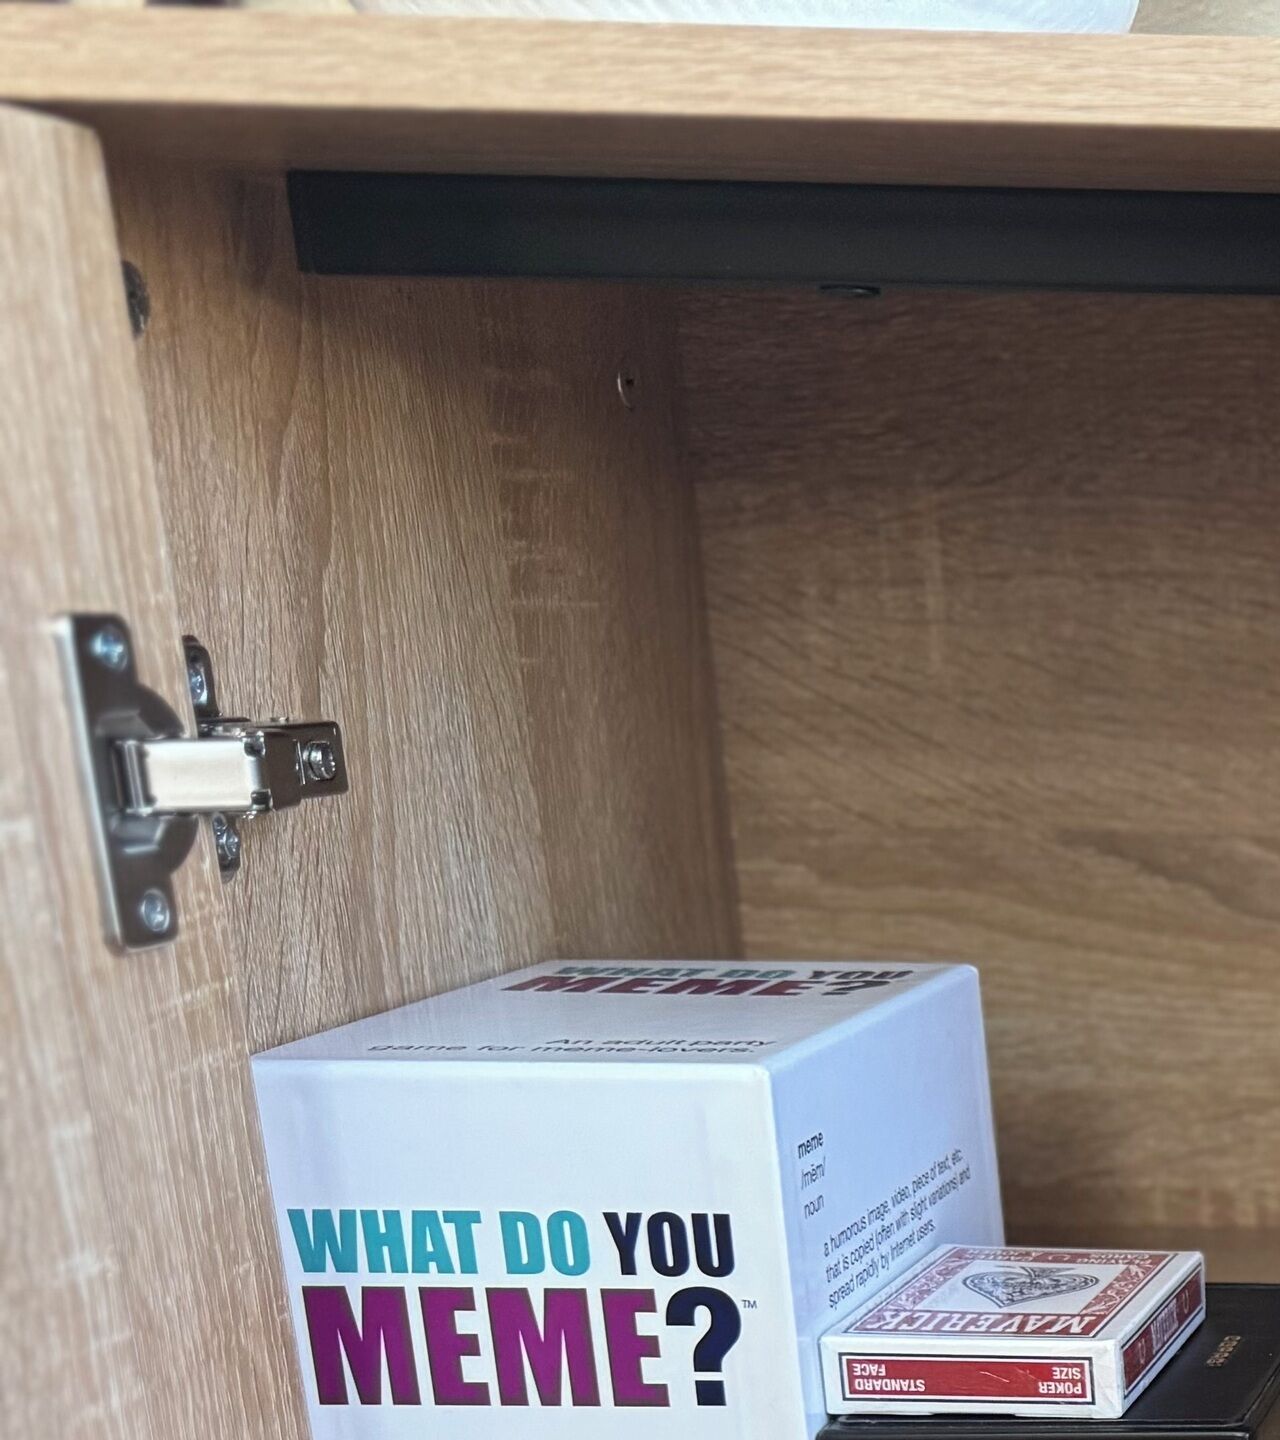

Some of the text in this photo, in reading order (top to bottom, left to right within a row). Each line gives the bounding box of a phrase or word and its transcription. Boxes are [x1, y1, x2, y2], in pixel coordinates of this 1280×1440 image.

[556, 967, 914, 980] WHAT DO YOU
[501, 976, 889, 997] MEME?
[602, 1038, 687, 1046] adult
[688, 1039, 778, 1047] party
[797, 1132, 824, 1159] meme
[804, 1194, 824, 1219] noun
[287, 1208, 736, 1278] WHAT DO YOU
[865, 1311, 1096, 1333] MAVERICK
[301, 1285, 742, 1407] MEME?
[853, 1363, 886, 1377] FACE
[1052, 1367, 1081, 1379] SIZE
[854, 1378, 925, 1391] STANDARD
[1039, 1382, 1082, 1394] POKER
